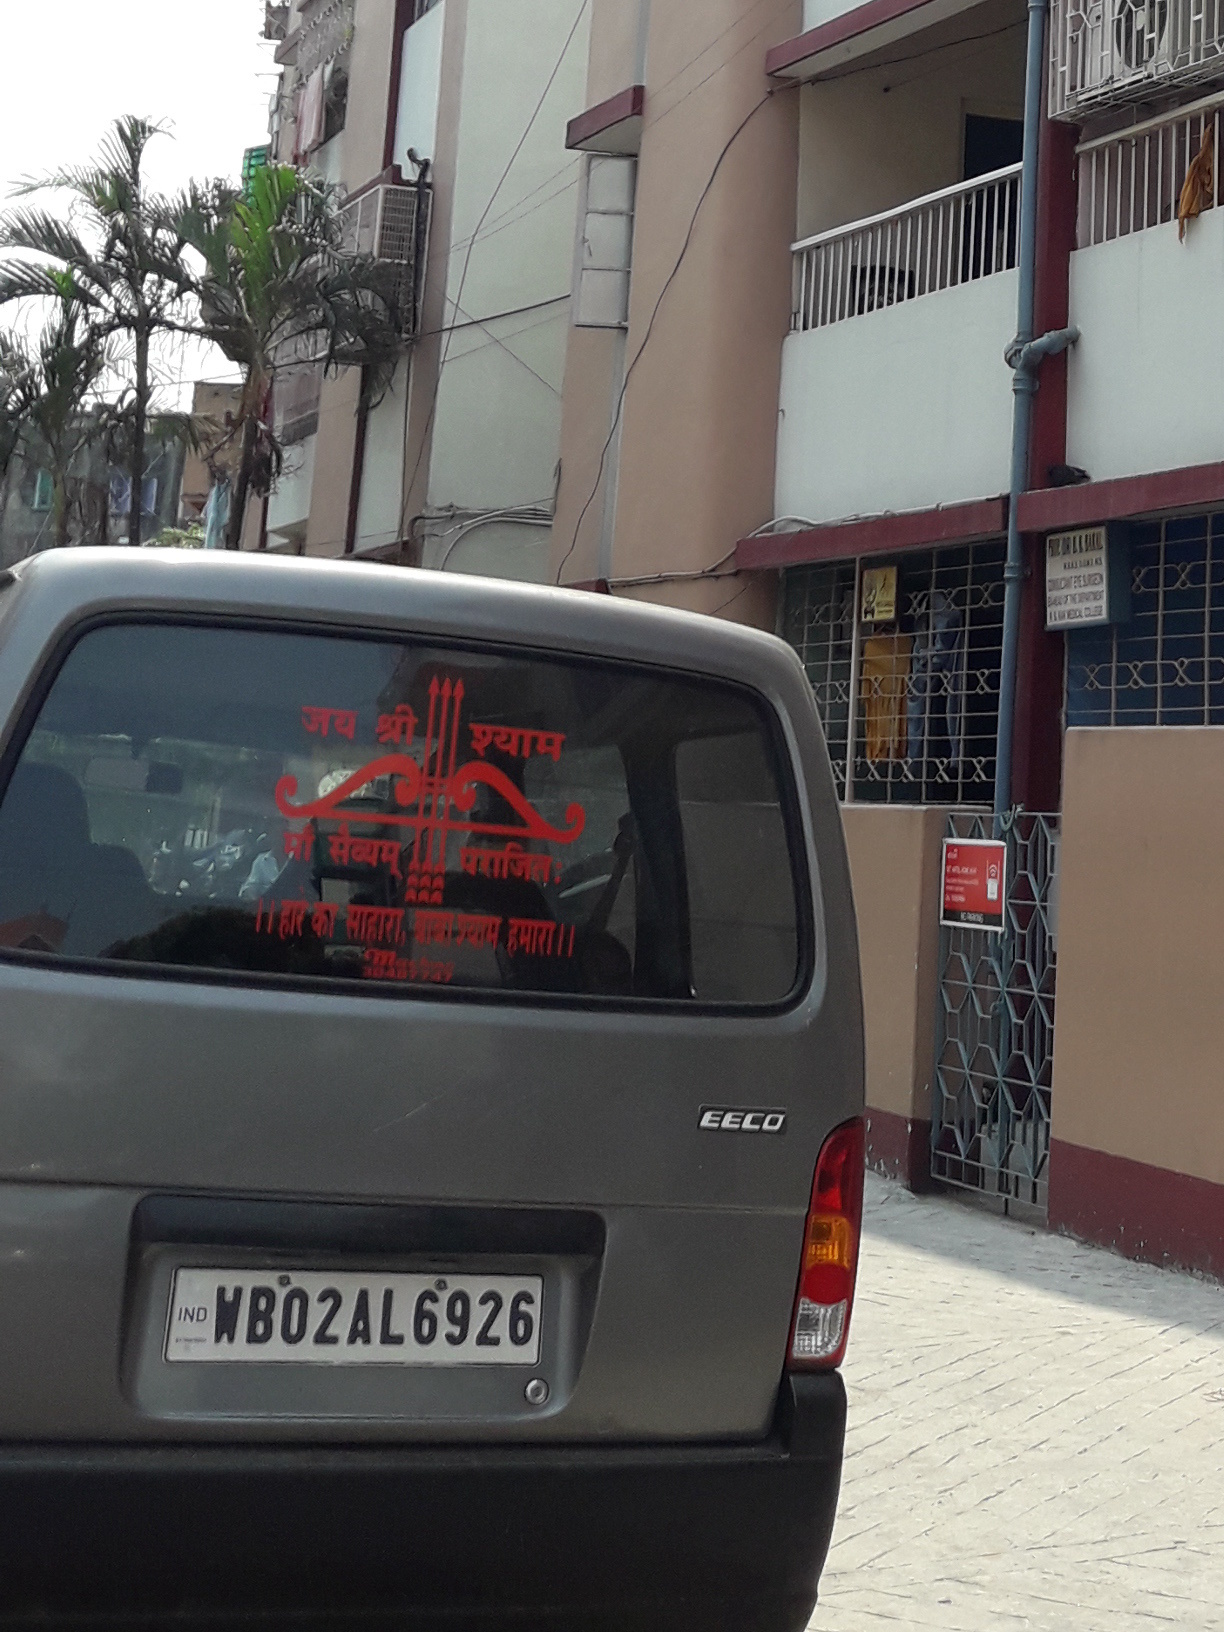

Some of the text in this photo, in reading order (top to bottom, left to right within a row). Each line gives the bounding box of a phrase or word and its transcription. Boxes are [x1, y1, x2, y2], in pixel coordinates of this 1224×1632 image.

[302, 703, 566, 761] जय श्री श्याम
[700, 1110, 786, 1133] EECO
[178, 1284, 536, 1347] IND WB02AL6926
